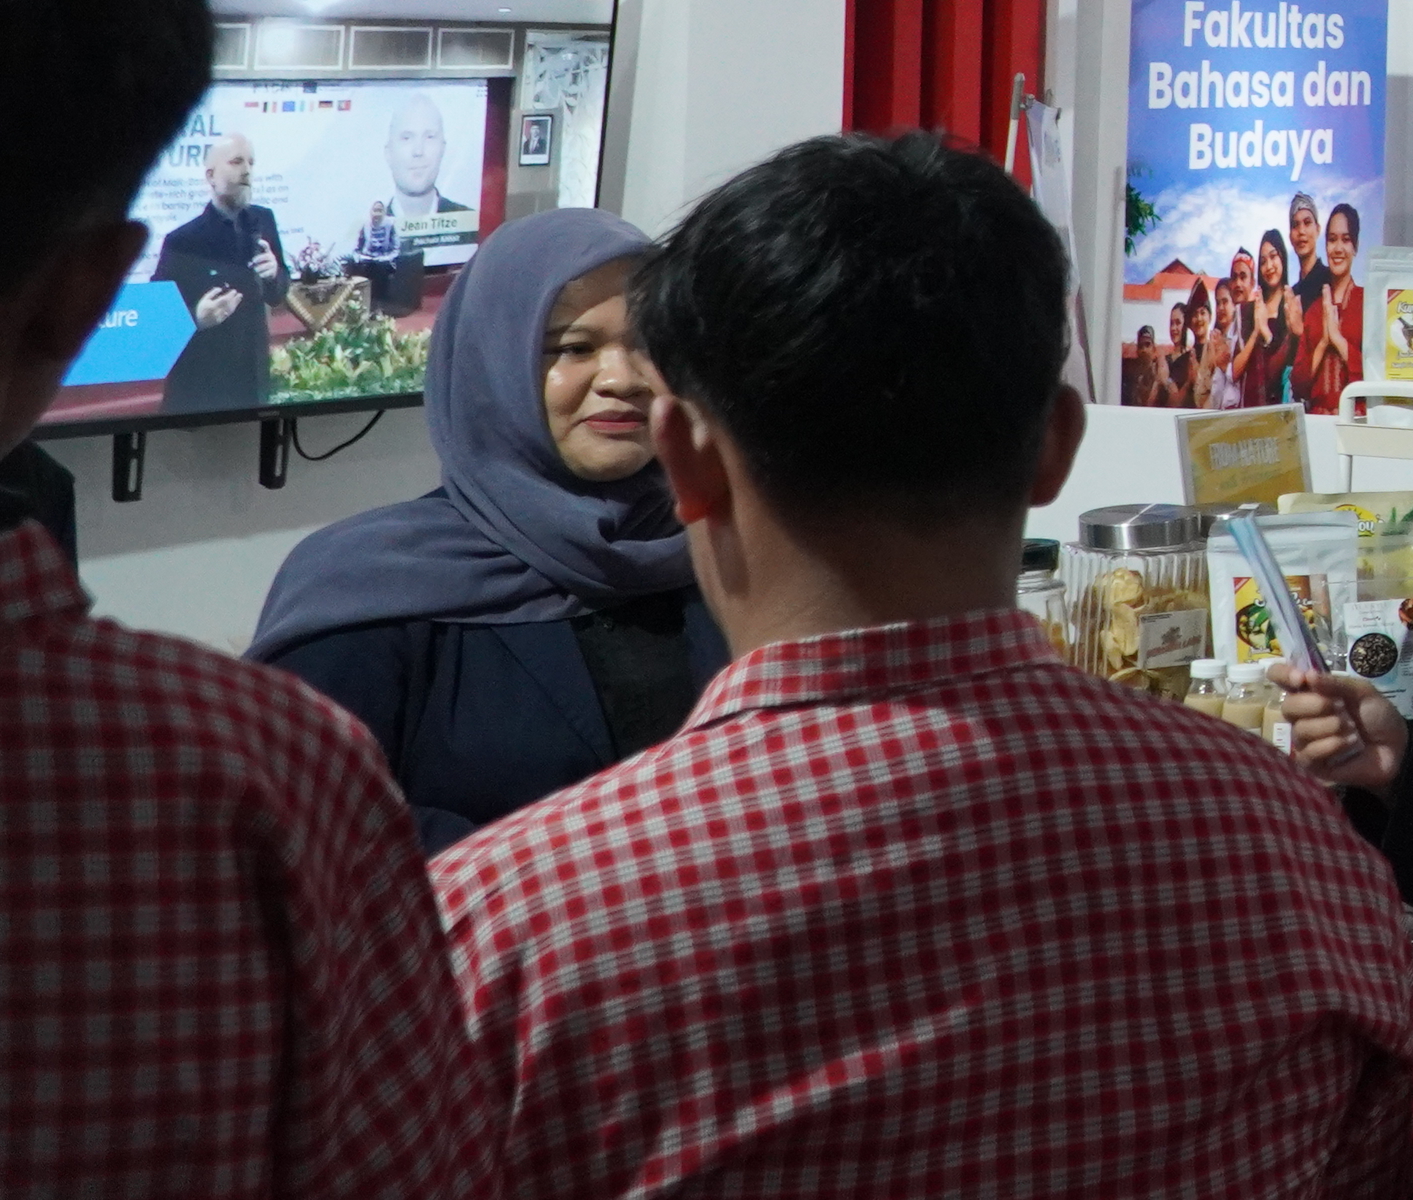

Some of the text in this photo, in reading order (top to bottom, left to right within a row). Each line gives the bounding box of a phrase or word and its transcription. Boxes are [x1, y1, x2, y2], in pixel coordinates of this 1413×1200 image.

[1183, 0, 1345, 49] Fakultas
[1148, 60, 1372, 109] Bahasa dan
[1188, 120, 1334, 182] Budaya
[401, 217, 458, 232] Jean Titze
